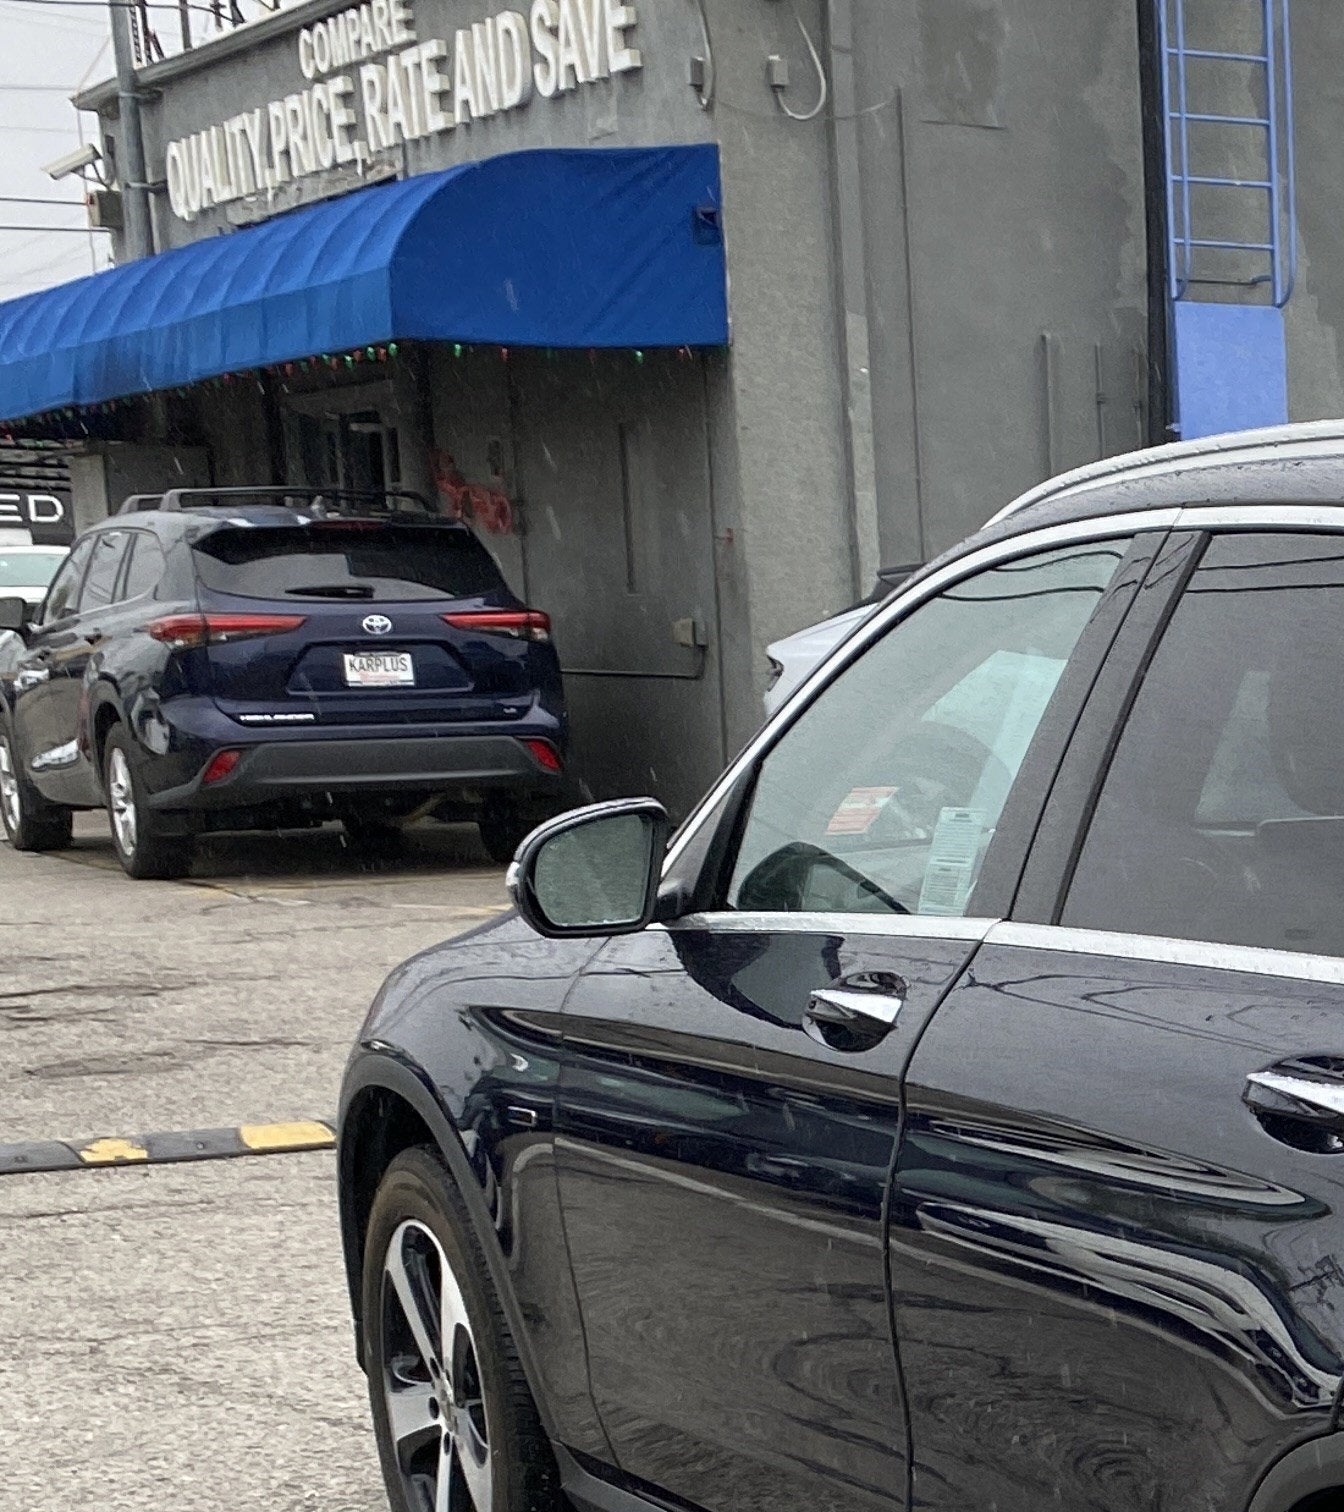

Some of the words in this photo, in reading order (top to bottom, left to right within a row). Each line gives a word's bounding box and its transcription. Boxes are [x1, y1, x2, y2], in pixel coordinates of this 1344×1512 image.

[299, 0, 417, 79] COMPARE
[360, 38, 456, 152] RATE
[454, 10, 532, 124] AND
[532, 0, 643, 98] SAVE
[349, 654, 409, 673] KARPLUS
